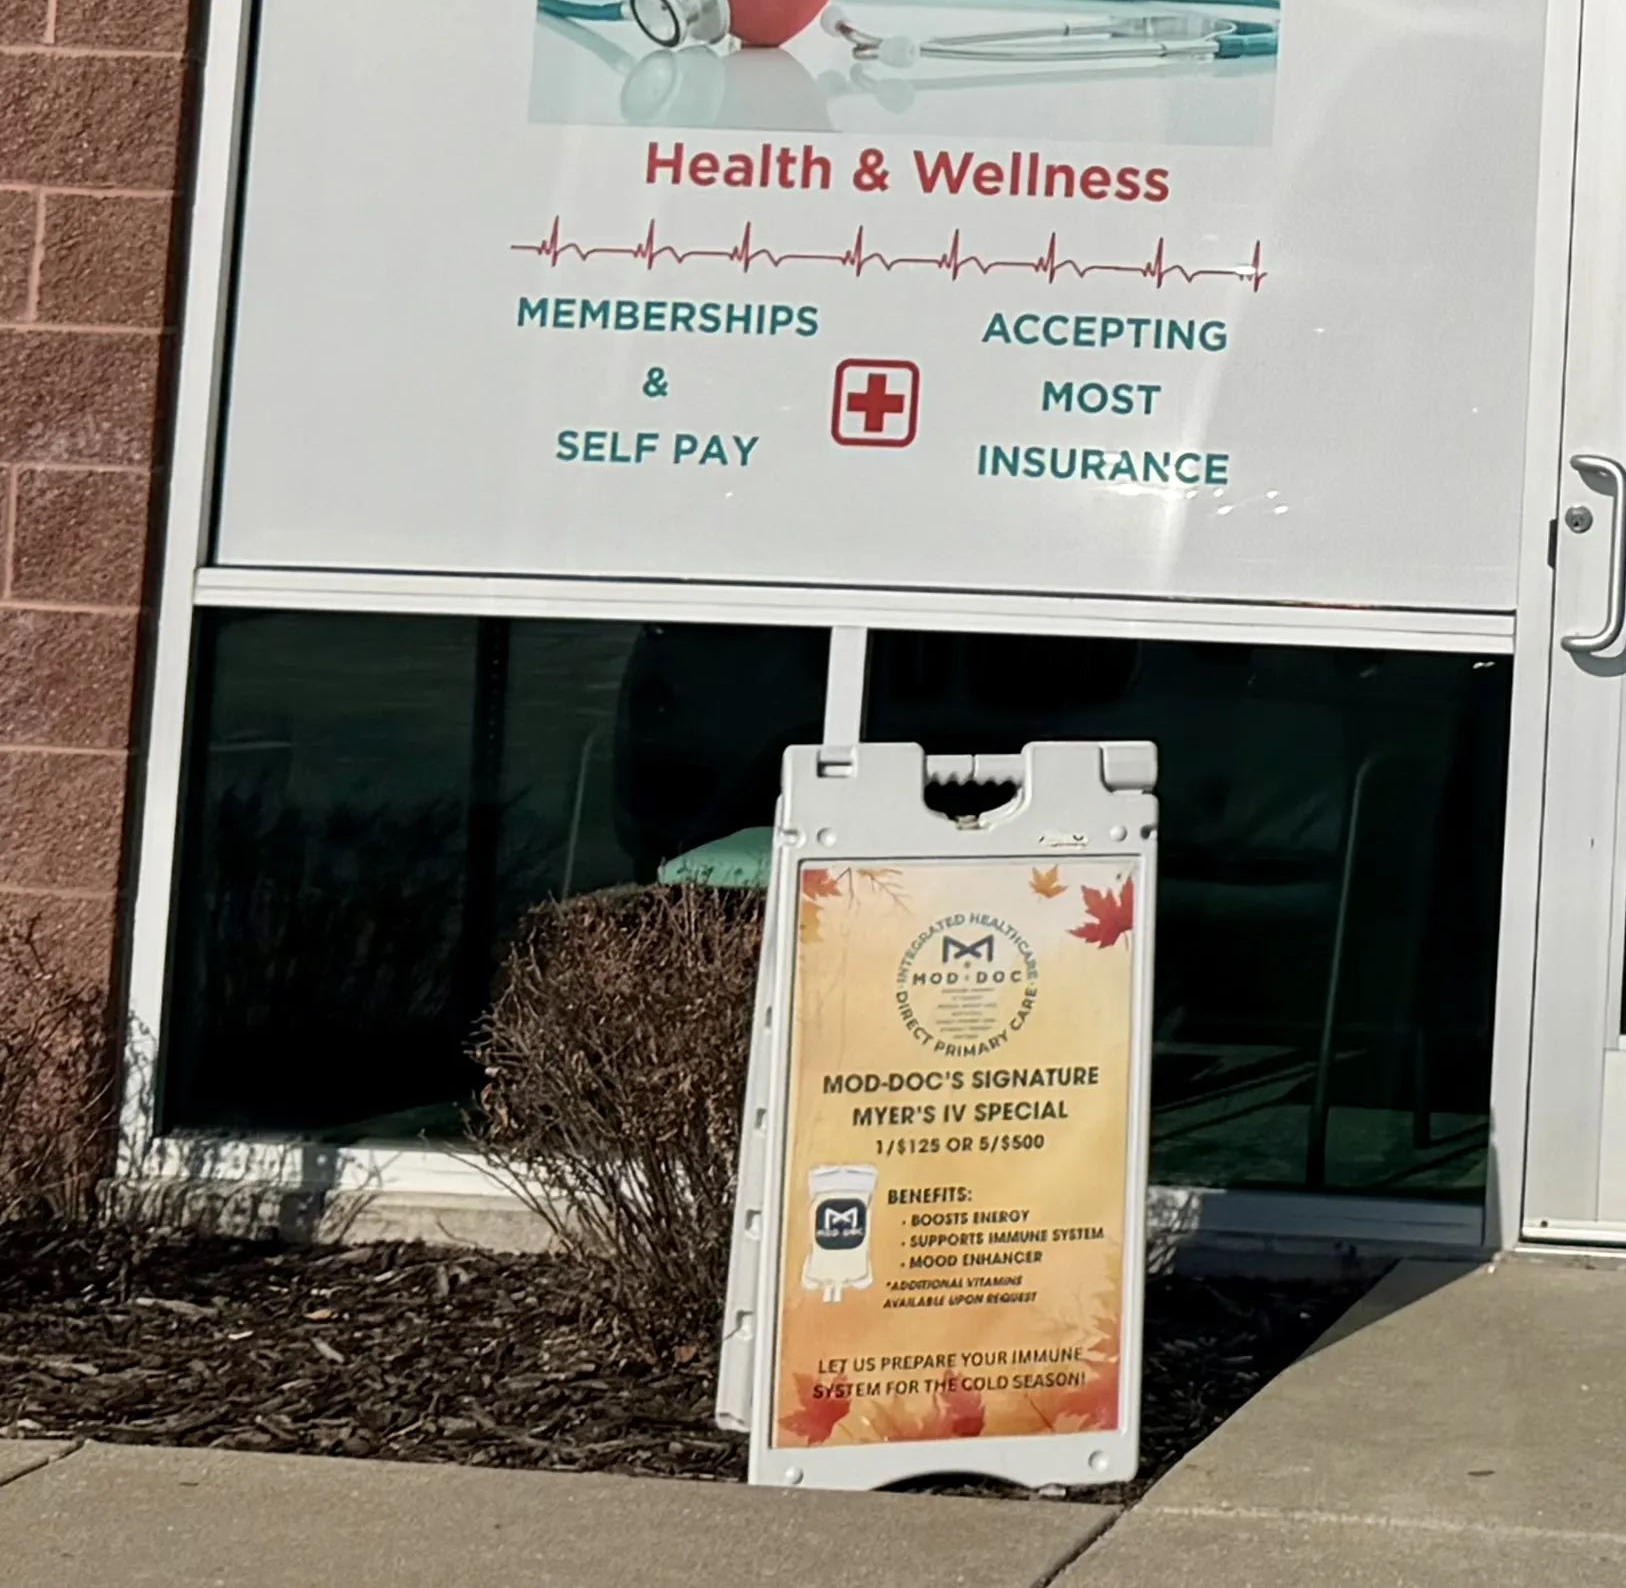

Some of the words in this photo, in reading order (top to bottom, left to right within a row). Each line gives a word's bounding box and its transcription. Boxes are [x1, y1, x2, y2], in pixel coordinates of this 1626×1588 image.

[645, 141, 832, 190] Health
[852, 147, 890, 192] &
[913, 150, 1170, 203] Wellness
[517, 297, 819, 337] MEMBERSHIPS
[982, 312, 1228, 352] ACCEPTING
[642, 368, 670, 398] &
[1042, 381, 1161, 415] MOST
[555, 430, 659, 464] SELF
[672, 432, 760, 467] PAY
[977, 444, 1230, 485] INSURANCE
[896, 913, 965, 983] INTEGRATED
[969, 912, 1038, 980] HEALTHCARE
[912, 972, 959, 986] MOD
[976, 970, 1022, 984] DOC
[896, 991, 934, 1046] DIRECT
[933, 1030, 1009, 1057] PRIMARY
[1009, 988, 1037, 1031] CARE
[823, 1071, 965, 1095] MOD-DOC'S
[971, 1066, 1100, 1090] SIGNATURE
[852, 1103, 937, 1127] MYER'S
[943, 1103, 967, 1123] IV
[974, 1100, 1069, 1123] SPECIAL
[875, 1137, 941, 1158] 1/$125
[946, 1136, 974, 1154] OR
[979, 1133, 1045, 1153] 5/$500
[887, 1186, 973, 1205] BENEFITS:
[911, 1212, 968, 1227] BOOSTS
[973, 1209, 1030, 1225] ENERGY
[910, 1232, 984, 1248] SUPPORTS
[989, 1229, 1048, 1245] IMMUNE
[1052, 1227, 1104, 1242] SYSTEM
[909, 1254, 958, 1270] MOOD
[963, 1250, 1043, 1267] ENHANCER
[967, 1275, 1024, 1288] VITAMINS
[883, 1295, 945, 1309] AVAILABLE
[949, 1293, 983, 1306] UPON
[986, 1291, 1038, 1305] REQUEST
[818, 1358, 848, 1375] LET
[853, 1356, 876, 1372] US
[880, 1353, 956, 1371] PREPARE
[960, 1350, 1007, 1367] YOUR
[1012, 1346, 1084, 1365] IMMUNE
[812, 1380, 881, 1399] SYSTEM
[886, 1379, 920, 1395] FOR
[924, 1376, 957, 1393] THE
[961, 1374, 1009, 1391] COLD
[1012, 1371, 1086, 1389] SEASON!
